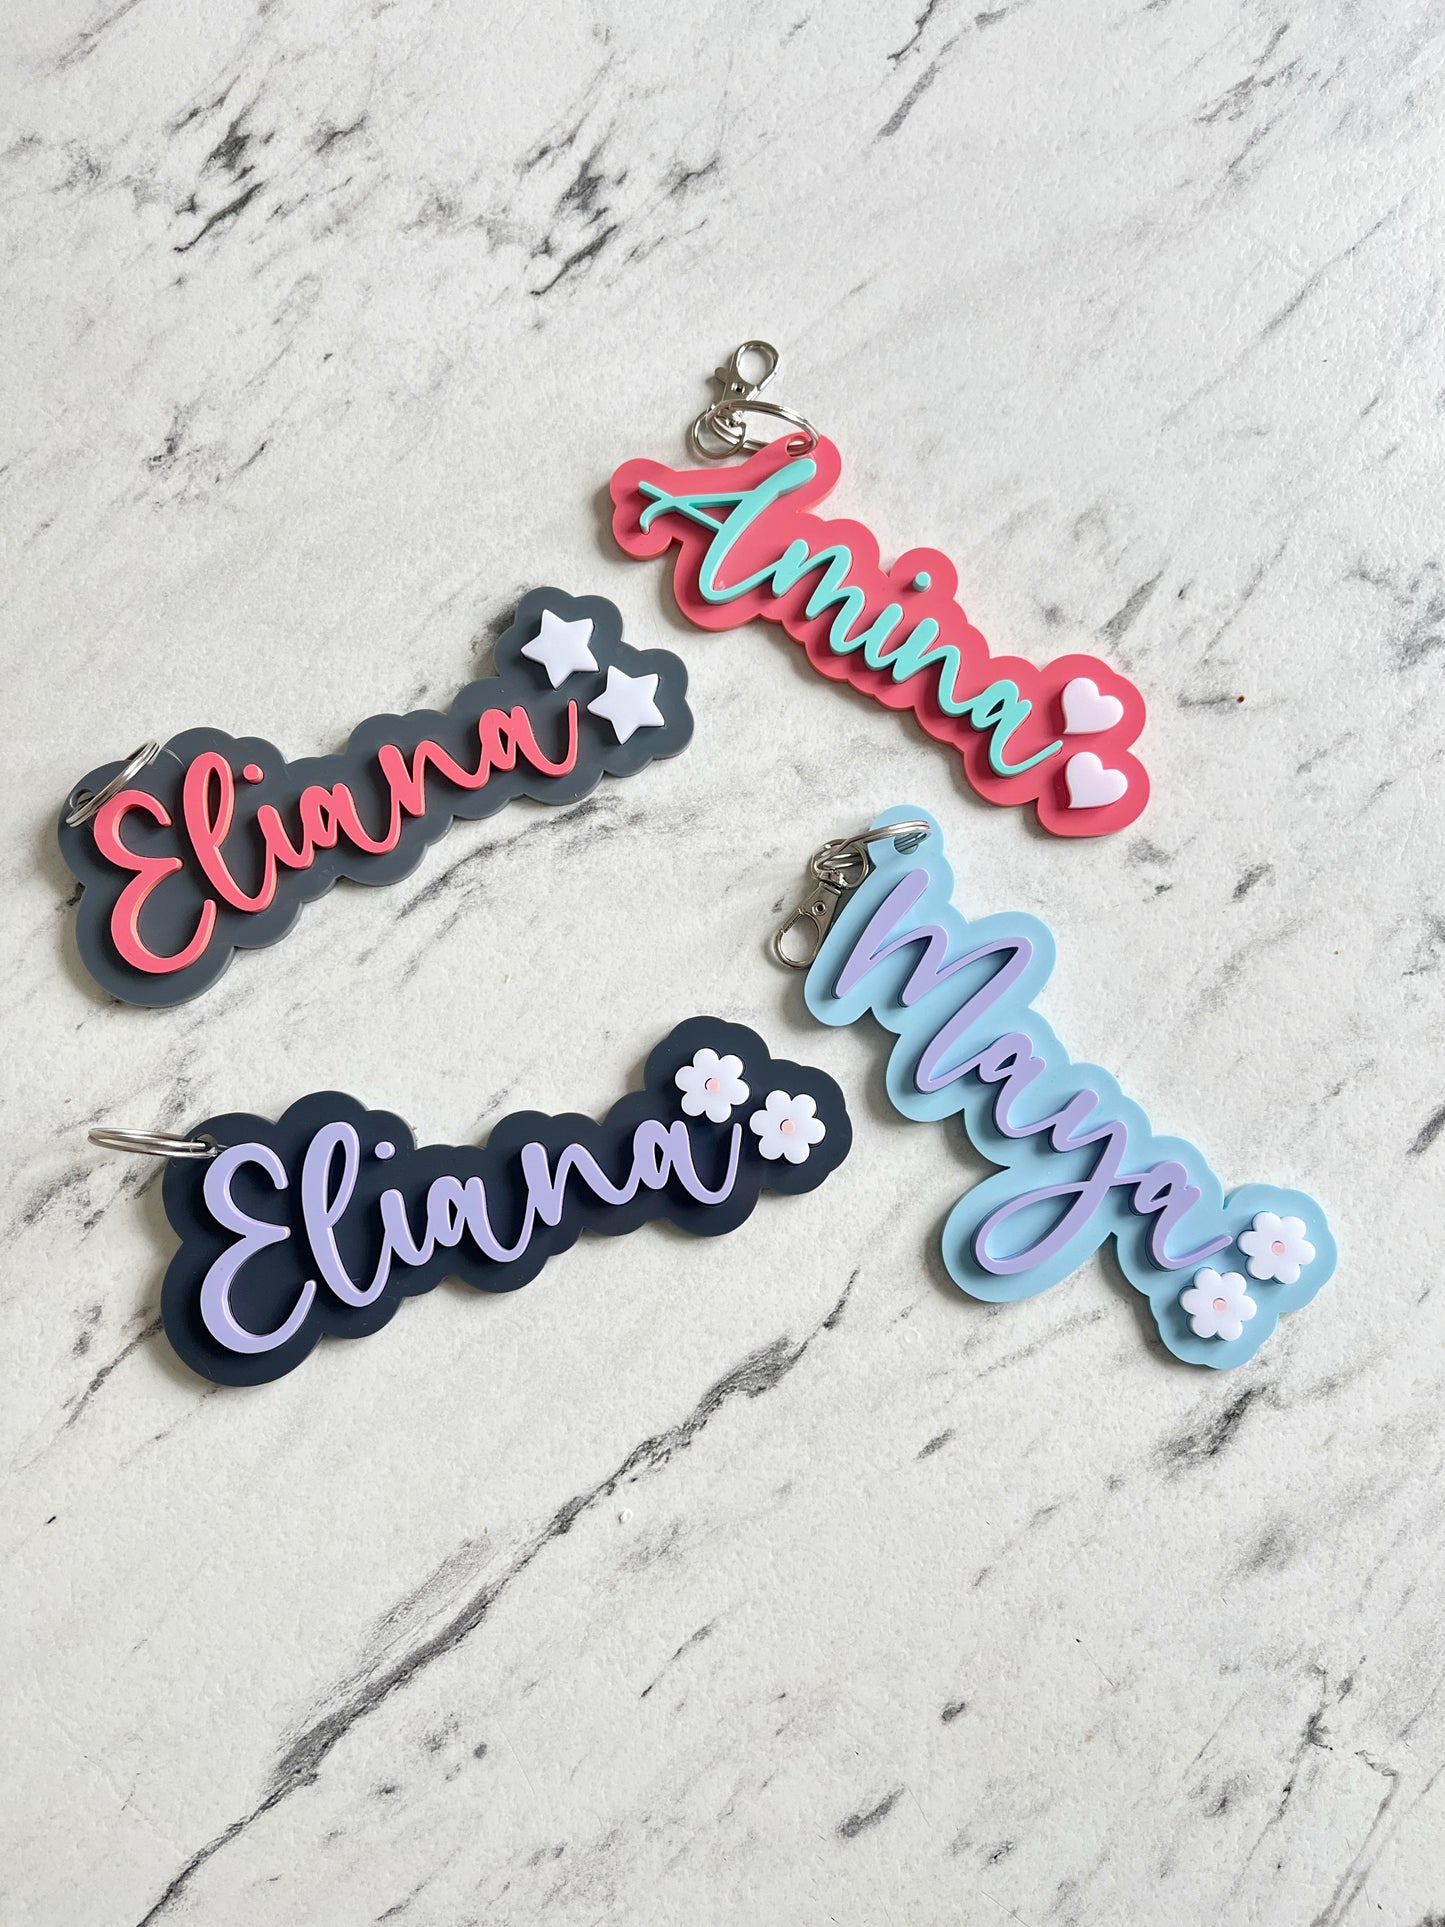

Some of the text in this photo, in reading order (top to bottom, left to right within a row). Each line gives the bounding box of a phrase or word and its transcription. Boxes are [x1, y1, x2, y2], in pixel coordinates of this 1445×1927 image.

[637, 458, 1063, 776] Amina
[94, 699, 579, 974] Eliana
[833, 868, 1232, 1273] Maya
[199, 1118, 742, 1354] Eliana
